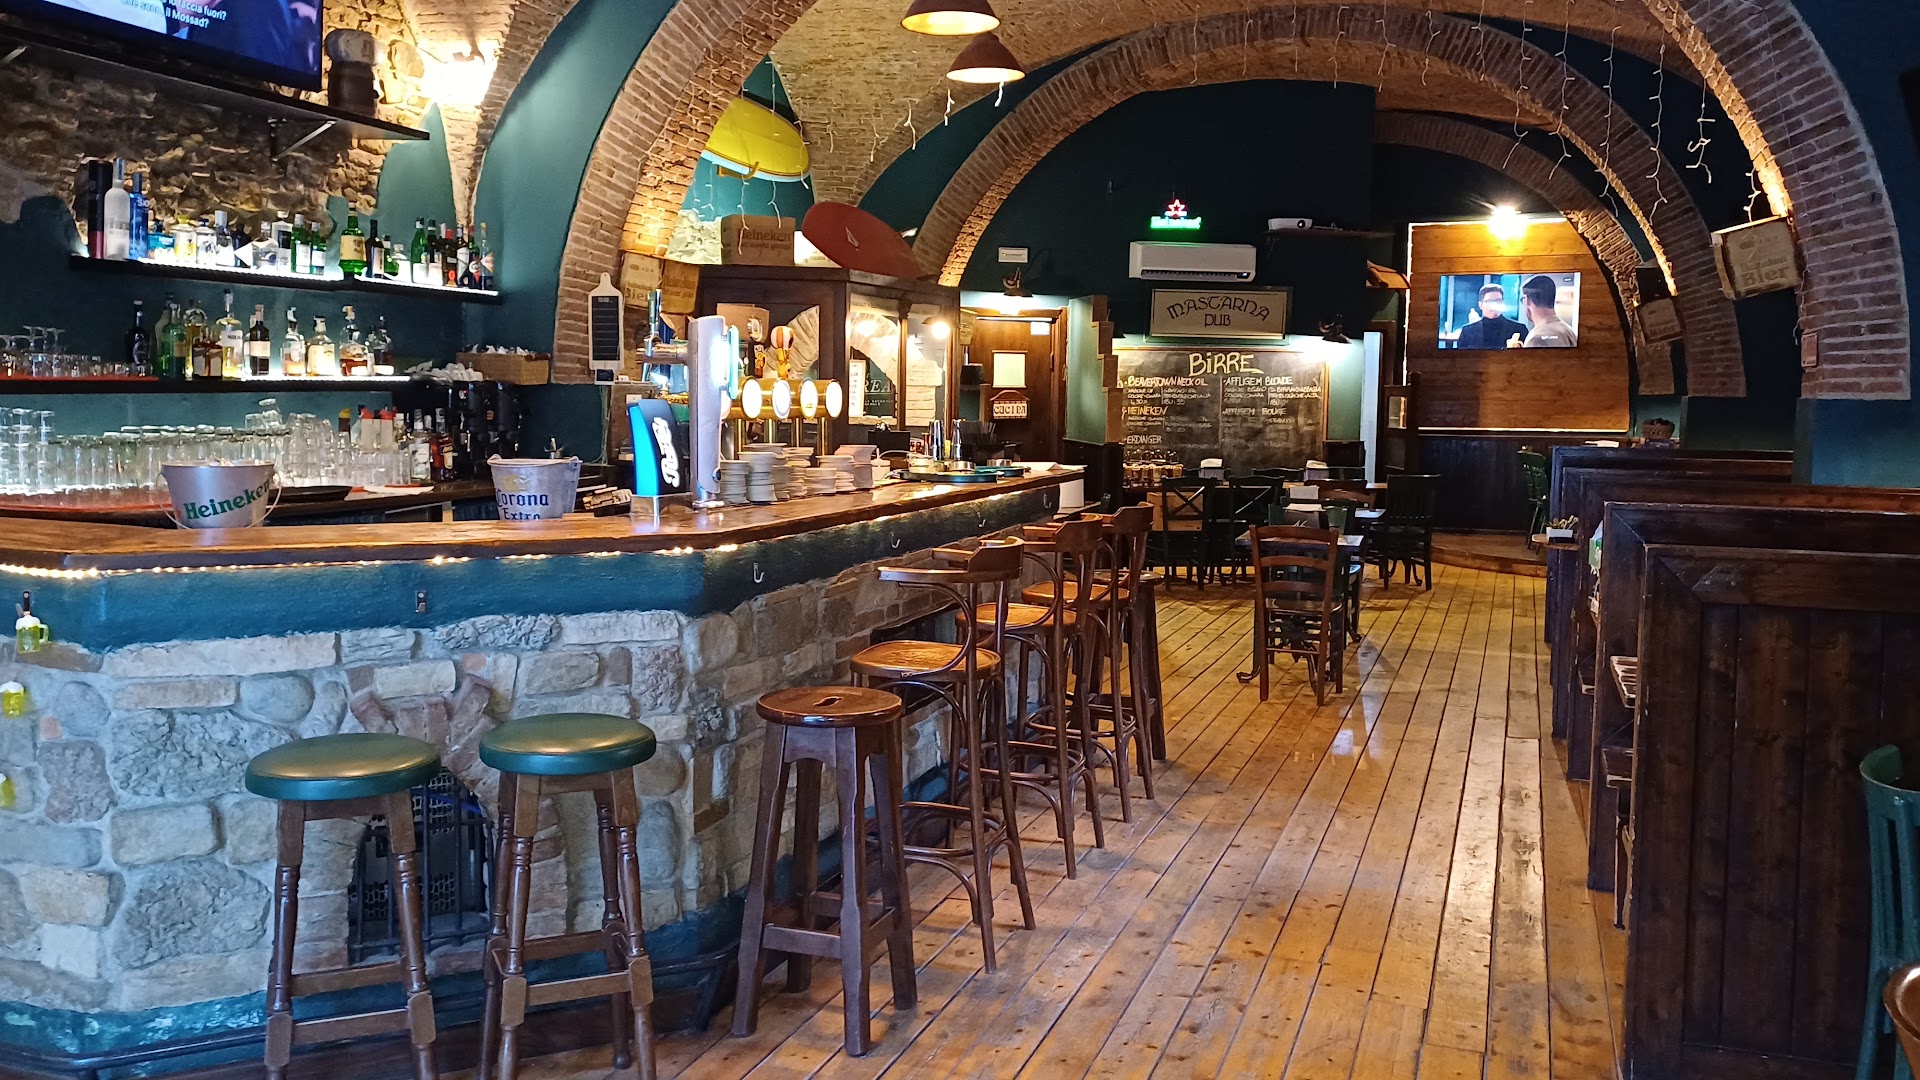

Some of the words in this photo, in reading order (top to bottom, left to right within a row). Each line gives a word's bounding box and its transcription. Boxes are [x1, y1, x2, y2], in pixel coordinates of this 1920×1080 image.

[172, 9, 210, 28] Mossad?
[203, 5, 227, 21] fuori?
[1166, 296, 1270, 321] MASTARNA
[1204, 314, 1231, 327] PUB
[1127, 375, 1176, 387] BEAVERTOWN
[1225, 376, 1262, 386] AFFLIGEM
[1264, 376, 1293, 386] BLONDE
[994, 405, 1027, 414] CUCINA
[1127, 405, 1169, 416] HEINEKEN
[1126, 435, 1162, 444] ERDINGER
[184, 479, 270, 519] Heineken
[496, 488, 549, 507] Corona
